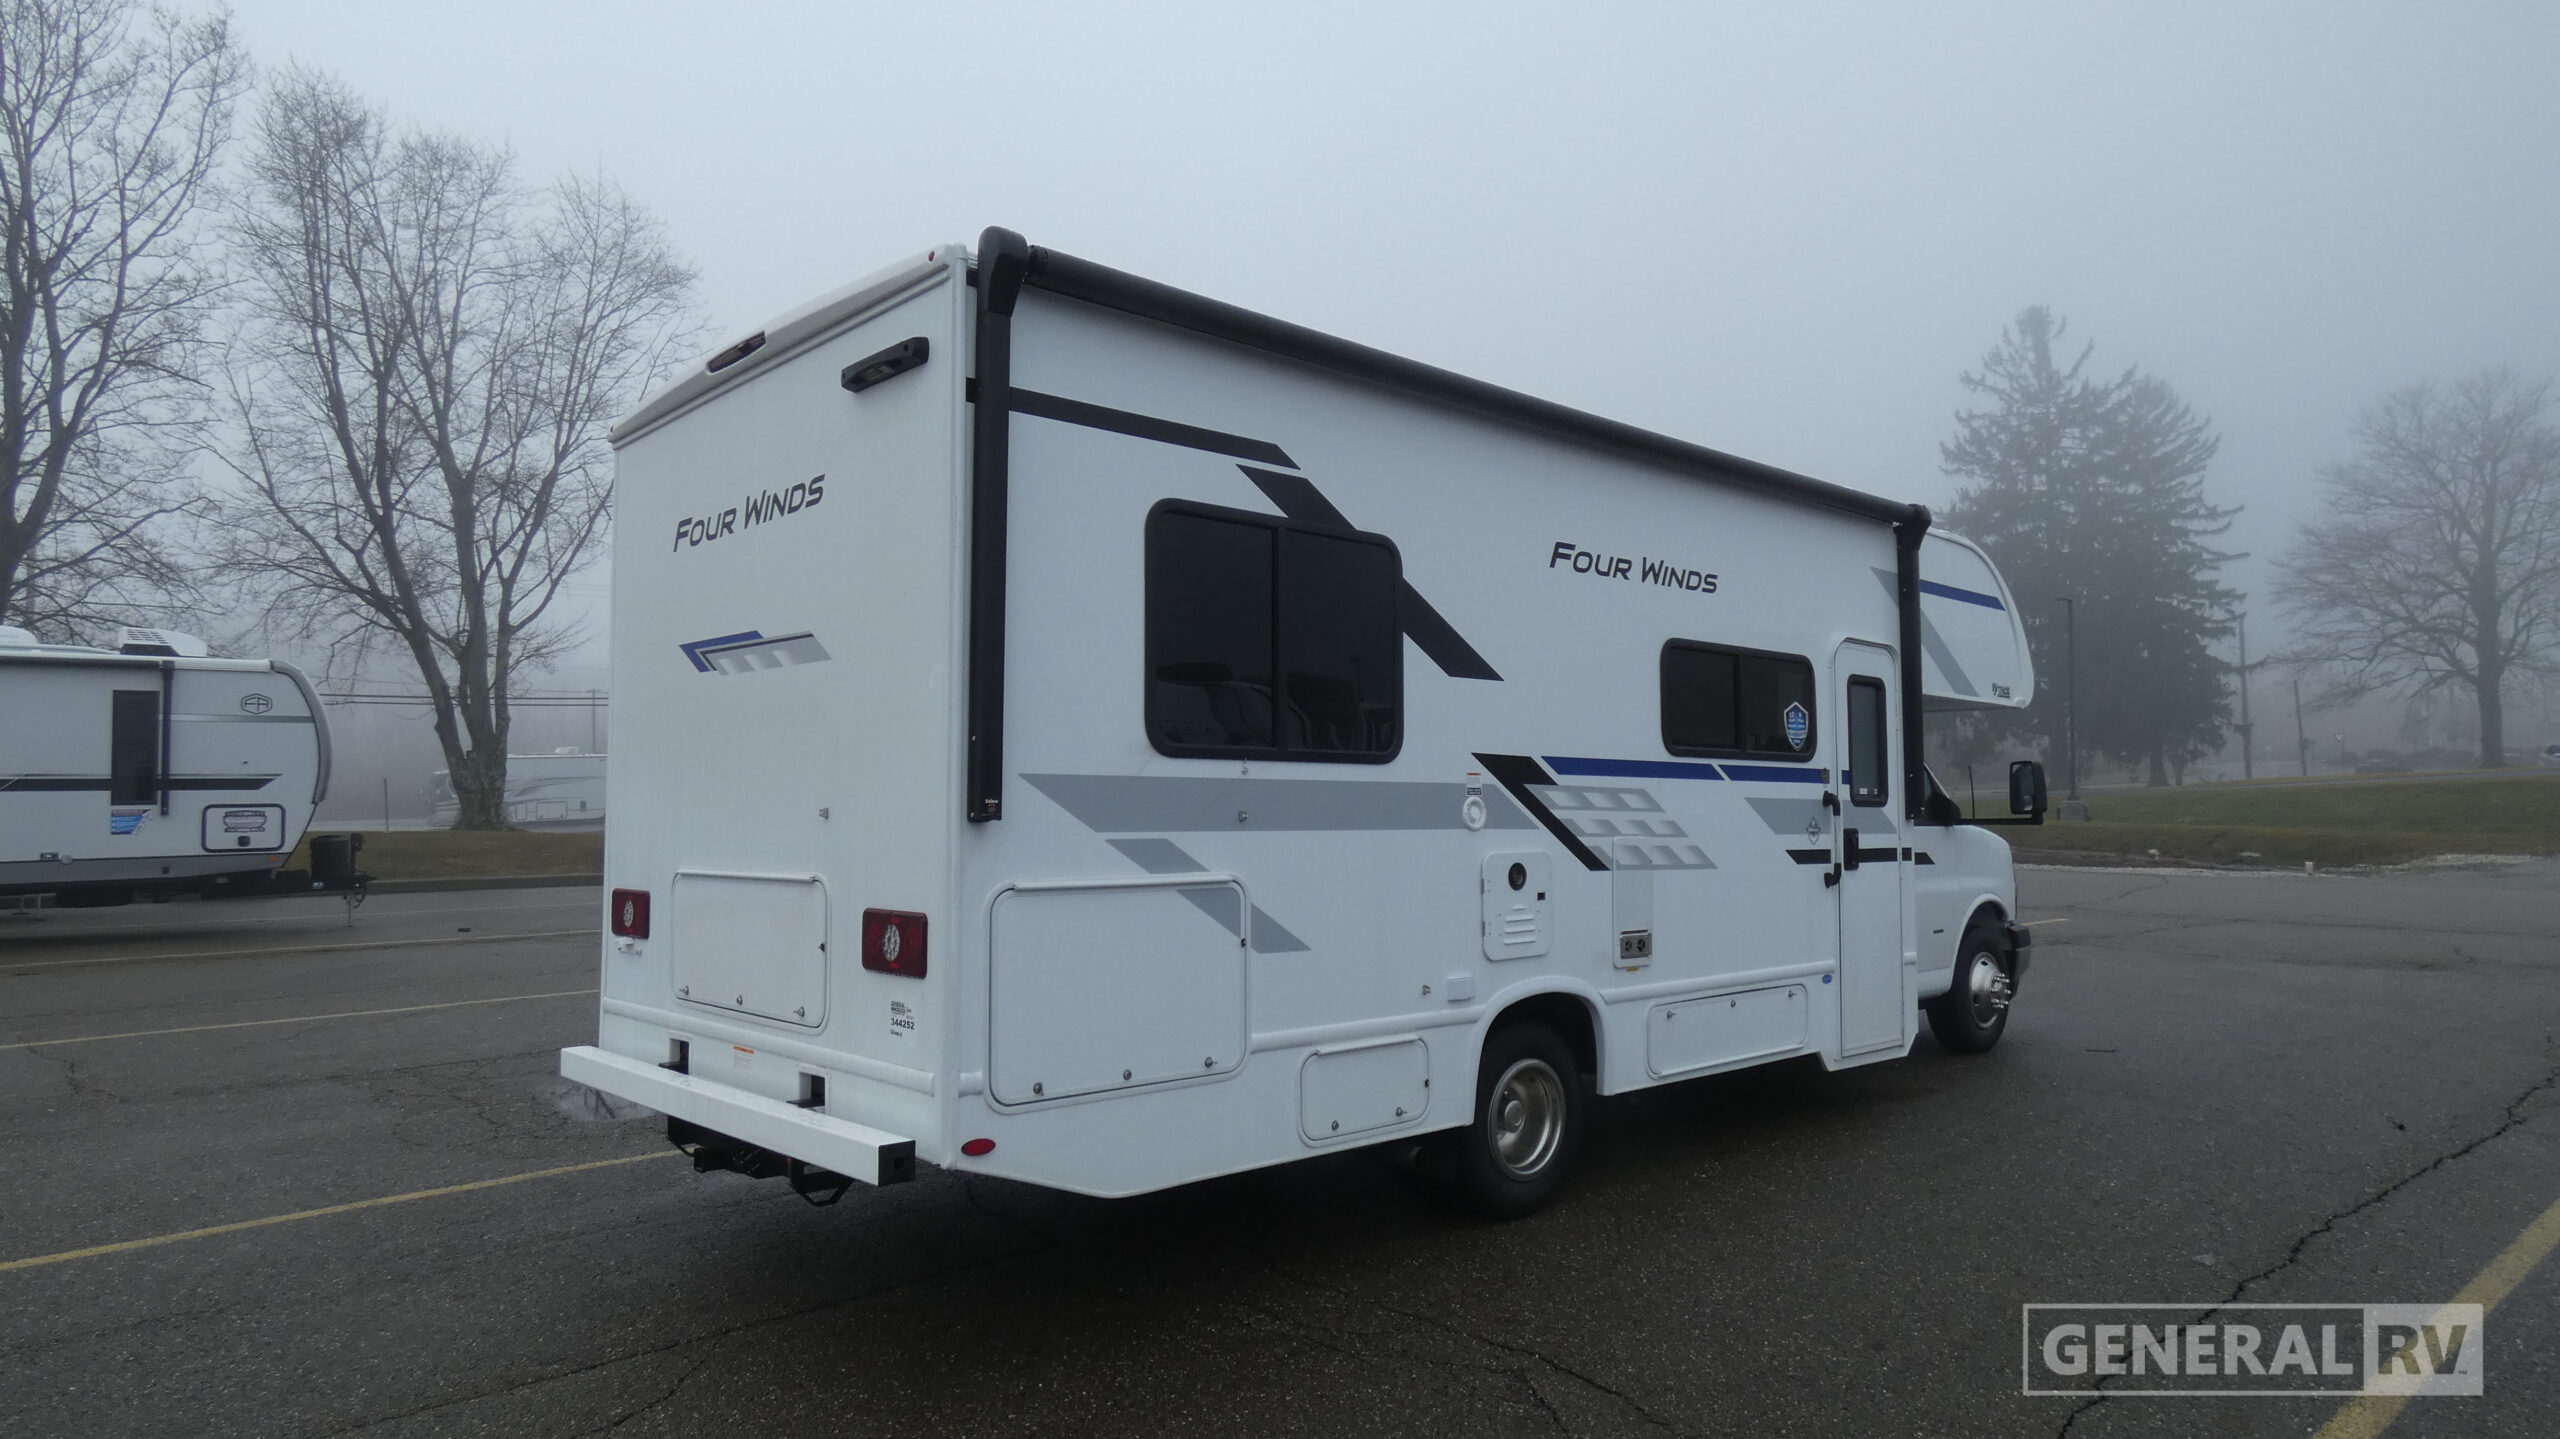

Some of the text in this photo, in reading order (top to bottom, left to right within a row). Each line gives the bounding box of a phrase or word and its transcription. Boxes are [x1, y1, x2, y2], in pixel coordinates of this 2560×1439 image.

[673, 473, 826, 553] FOUR WINDS
[1549, 541, 1719, 594] FOUR WINDS
[890, 1017, 915, 1031] 344252
